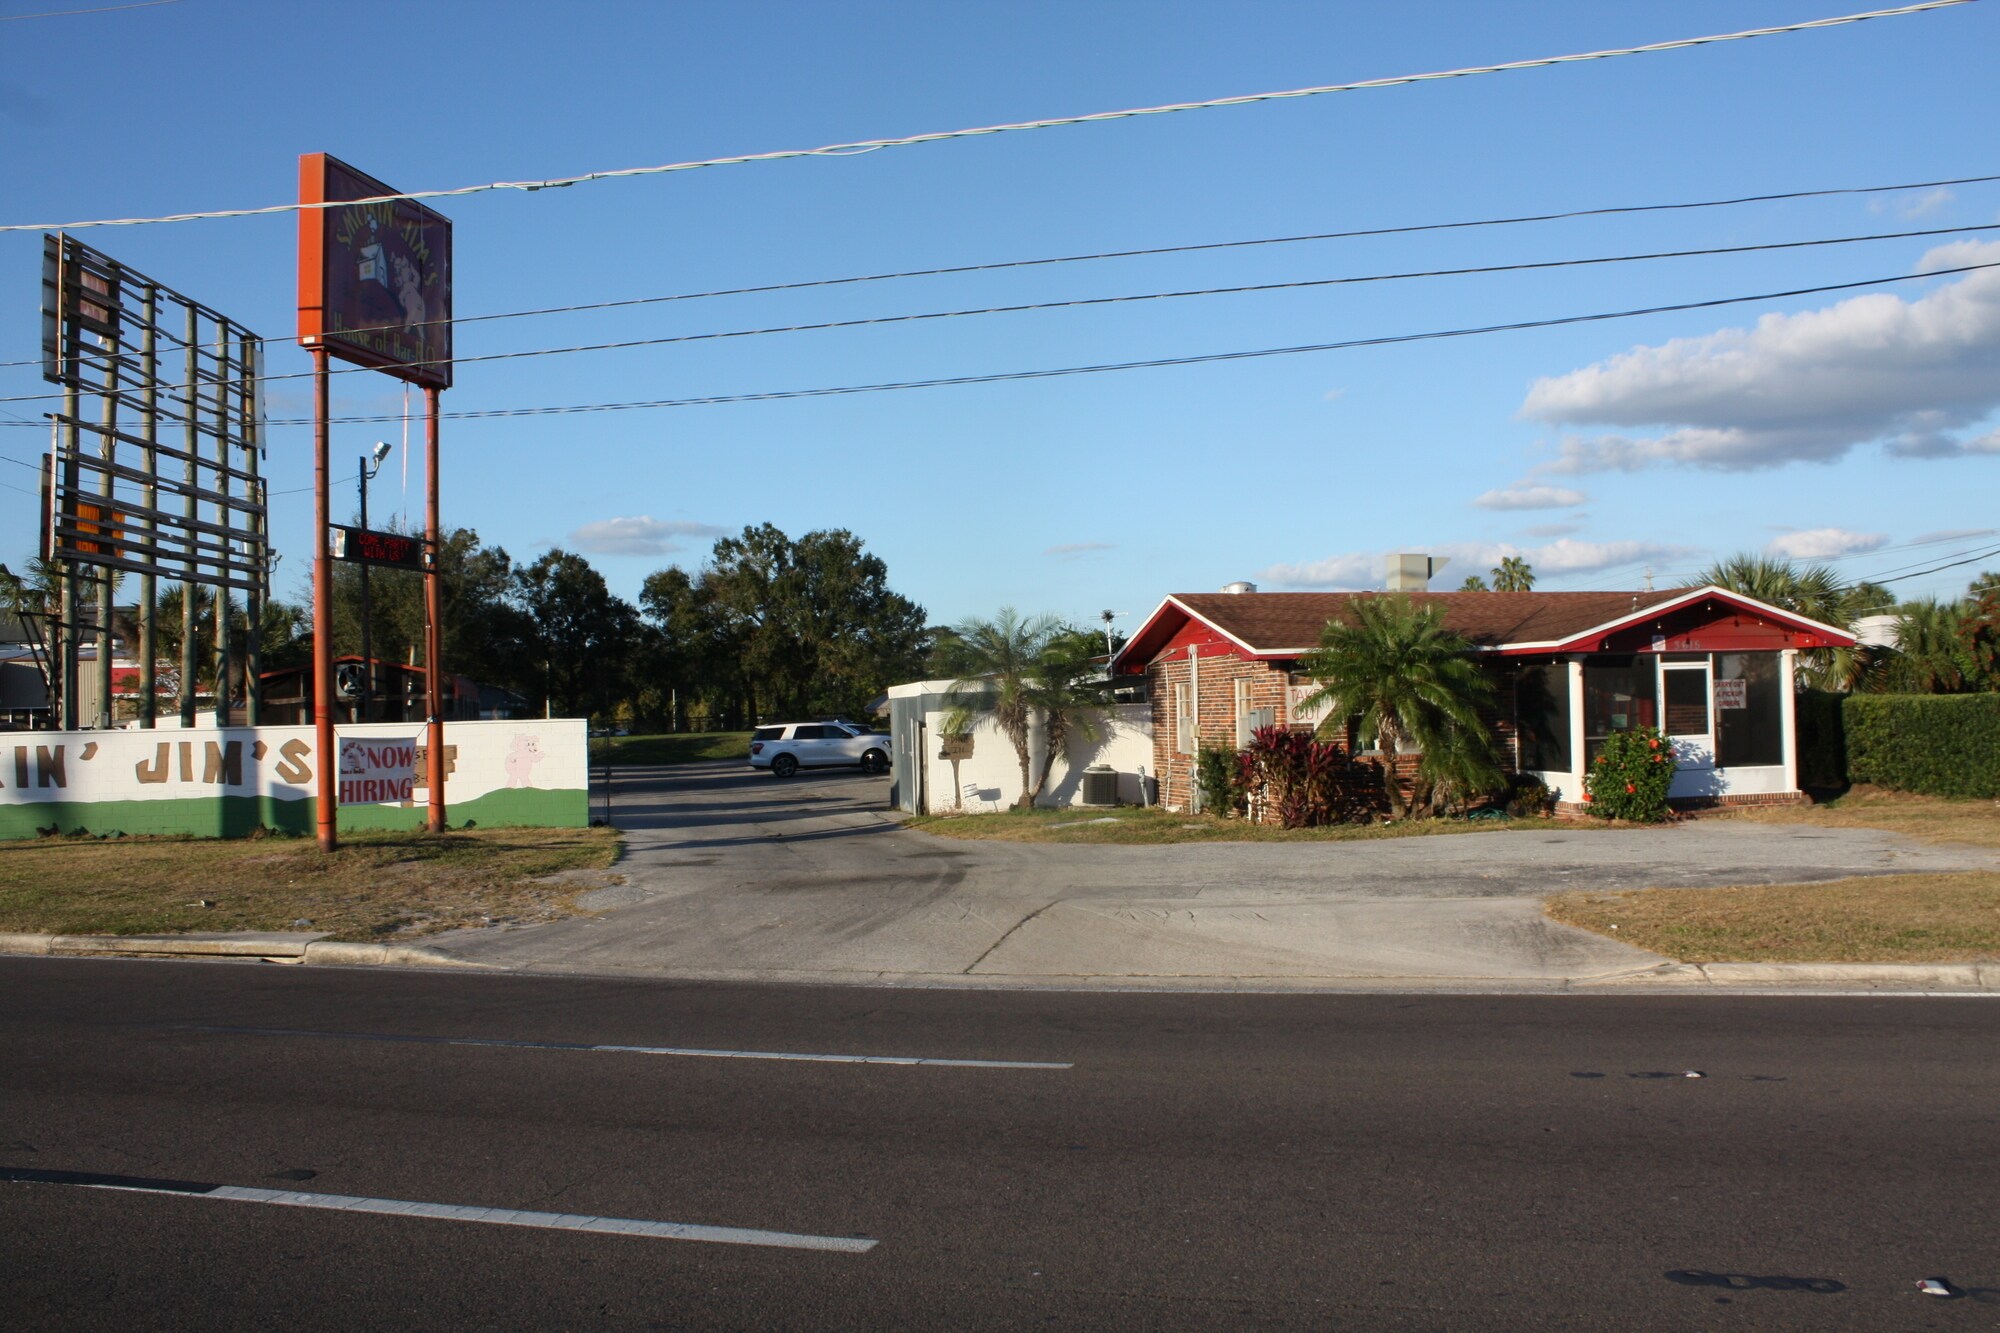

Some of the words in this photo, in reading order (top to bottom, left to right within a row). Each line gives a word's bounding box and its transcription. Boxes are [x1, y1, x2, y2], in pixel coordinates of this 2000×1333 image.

[334, 311, 371, 348] House
[375, 328, 388, 353] of
[364, 544, 386, 559] WITH
[384, 536, 409, 551] PARTY
[135, 738, 313, 786] JIM'S
[367, 746, 415, 769] NOW
[339, 777, 413, 803] HIRING
